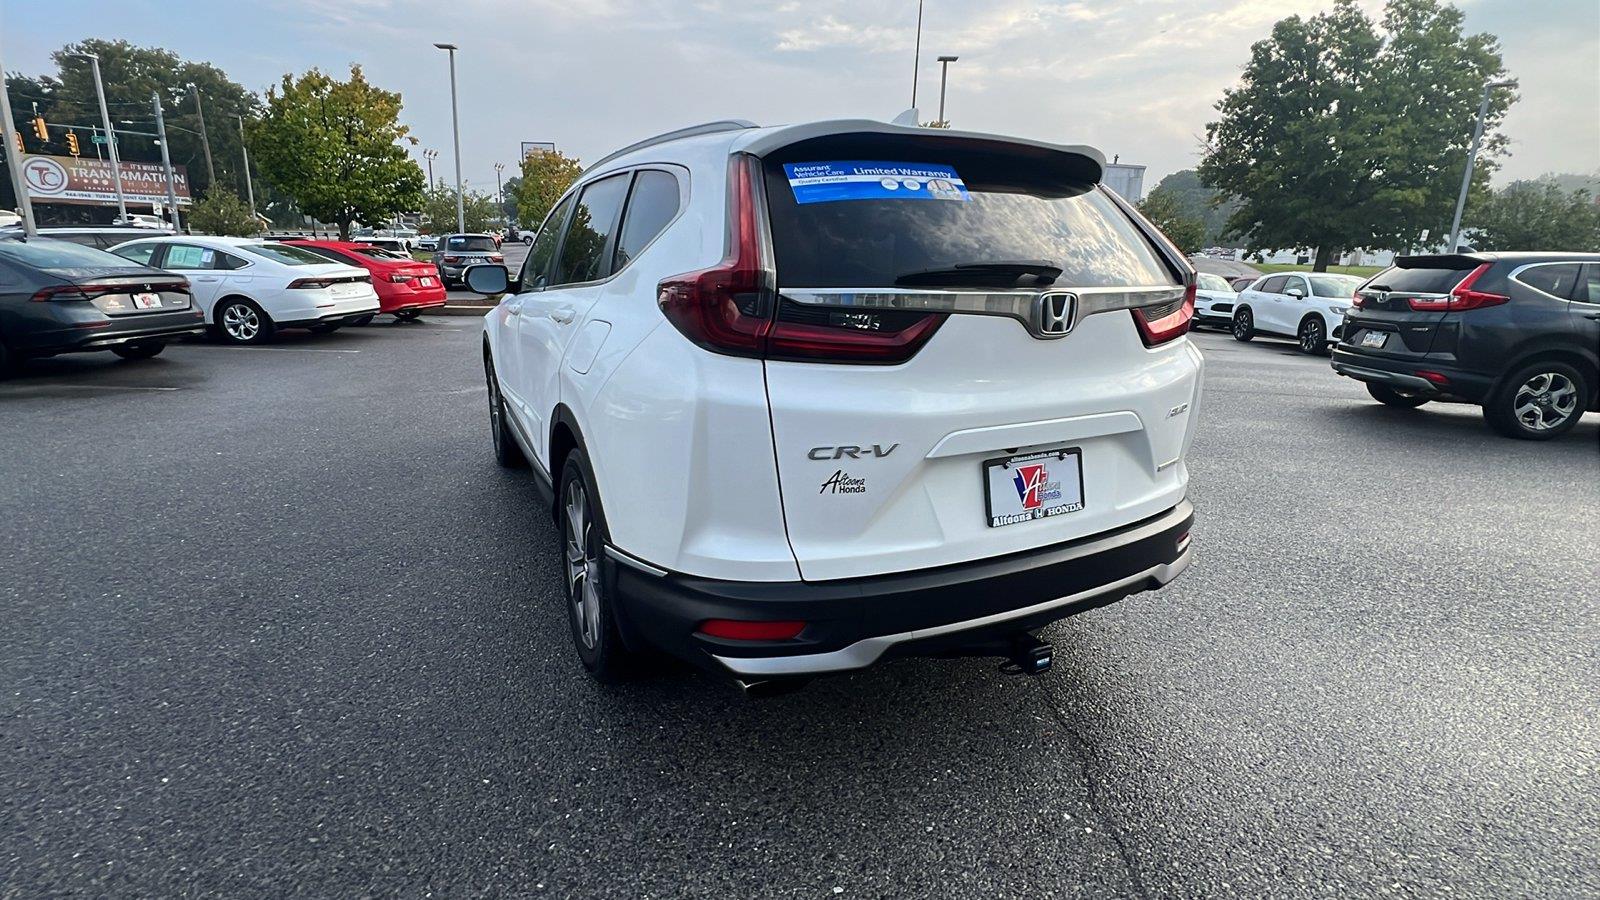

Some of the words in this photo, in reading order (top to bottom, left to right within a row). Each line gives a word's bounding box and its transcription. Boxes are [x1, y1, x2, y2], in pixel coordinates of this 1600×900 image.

[69, 166, 186, 184] TRAN4MATIN
[853, 167, 897, 176] Limited
[898, 168, 952, 179] Warranty
[807, 443, 900, 460] CR-V
[838, 485, 867, 494] Honda
[992, 512, 1033, 527] Altoona
[1046, 502, 1083, 516] HONDA
